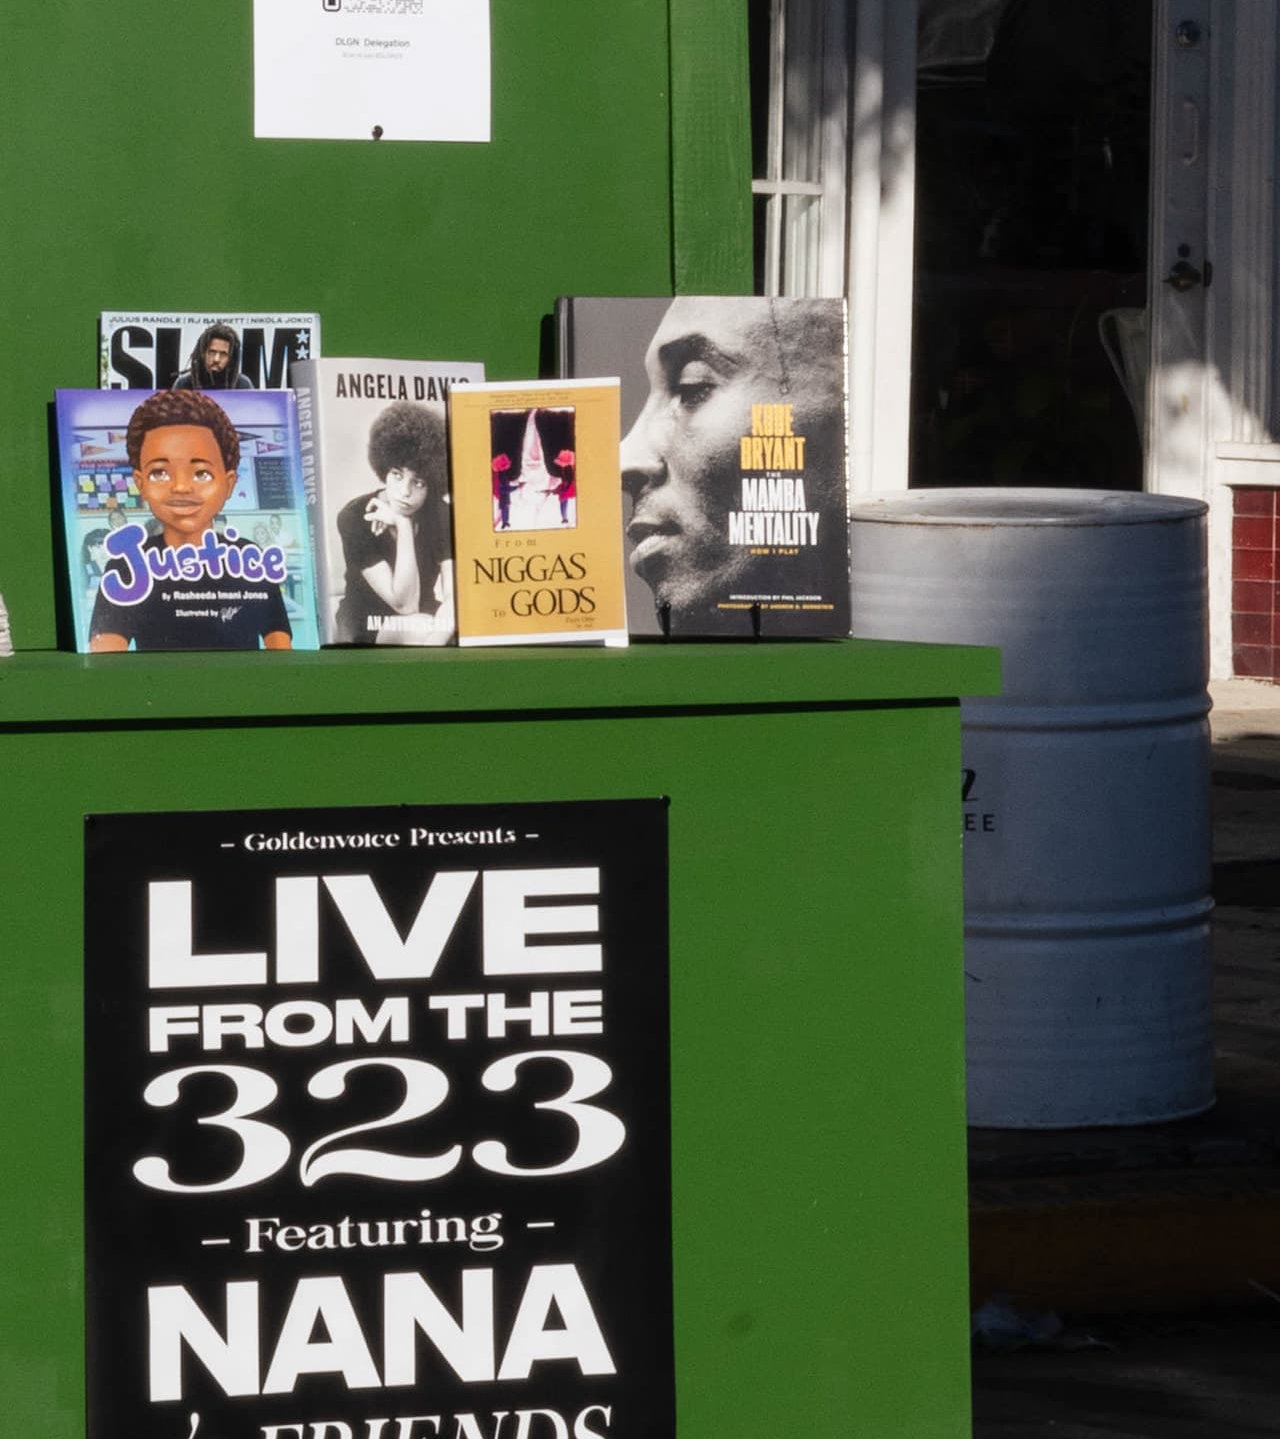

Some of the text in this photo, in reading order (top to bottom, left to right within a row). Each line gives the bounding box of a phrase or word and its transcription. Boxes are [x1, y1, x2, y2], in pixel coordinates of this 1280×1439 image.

[363, 38, 411, 50] Delegation
[109, 316, 140, 324] JULIUS
[142, 316, 182, 324] RANDLE
[336, 373, 409, 400] ANGELA
[414, 376, 470, 402] DAV
[295, 387, 314, 454] ANGELA
[740, 437, 806, 470] BRYANT
[301, 455, 317, 506] DAVIS
[742, 478, 806, 511] MAMBA
[495, 538, 537, 548] From
[728, 511, 820, 546] MENTALITY
[101, 523, 287, 606] Justice
[473, 552, 587, 584] NIGGAS
[510, 586, 596, 617] GODS
[244, 827, 517, 852] Goldenvoice Presents
[148, 866, 603, 989] LIVE
[148, 989, 603, 1053] FROM THE
[132, 1049, 626, 1193] 323
[244, 1209, 504, 1253] Featuring
[147, 1263, 617, 1402] NANA
